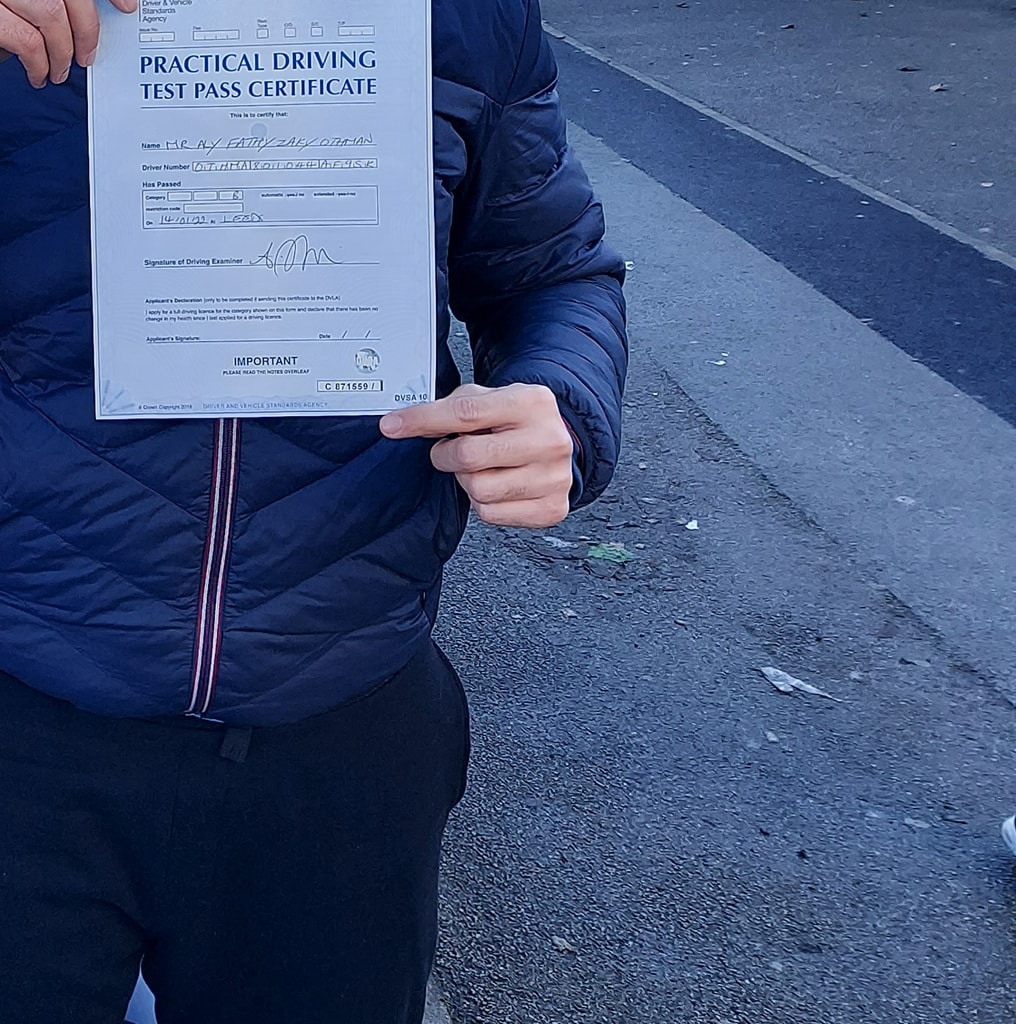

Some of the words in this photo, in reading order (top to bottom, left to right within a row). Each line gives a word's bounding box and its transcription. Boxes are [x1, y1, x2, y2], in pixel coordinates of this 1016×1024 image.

[142, 16, 168, 24] Agency
[140, 53, 264, 74] PRACTICAL
[273, 50, 376, 70] DRIVING
[140, 83, 187, 100] TEST
[194, 82, 242, 99] PASS
[249, 79, 377, 97] CERTIFICATE
[144, 259, 177, 267] Signature
[186, 258, 211, 266] Driving
[234, 356, 298, 367] IMPORTANT
[325, 383, 332, 391] C
[335, 383, 369, 391] 871559
[395, 394, 417, 402] DVSA
